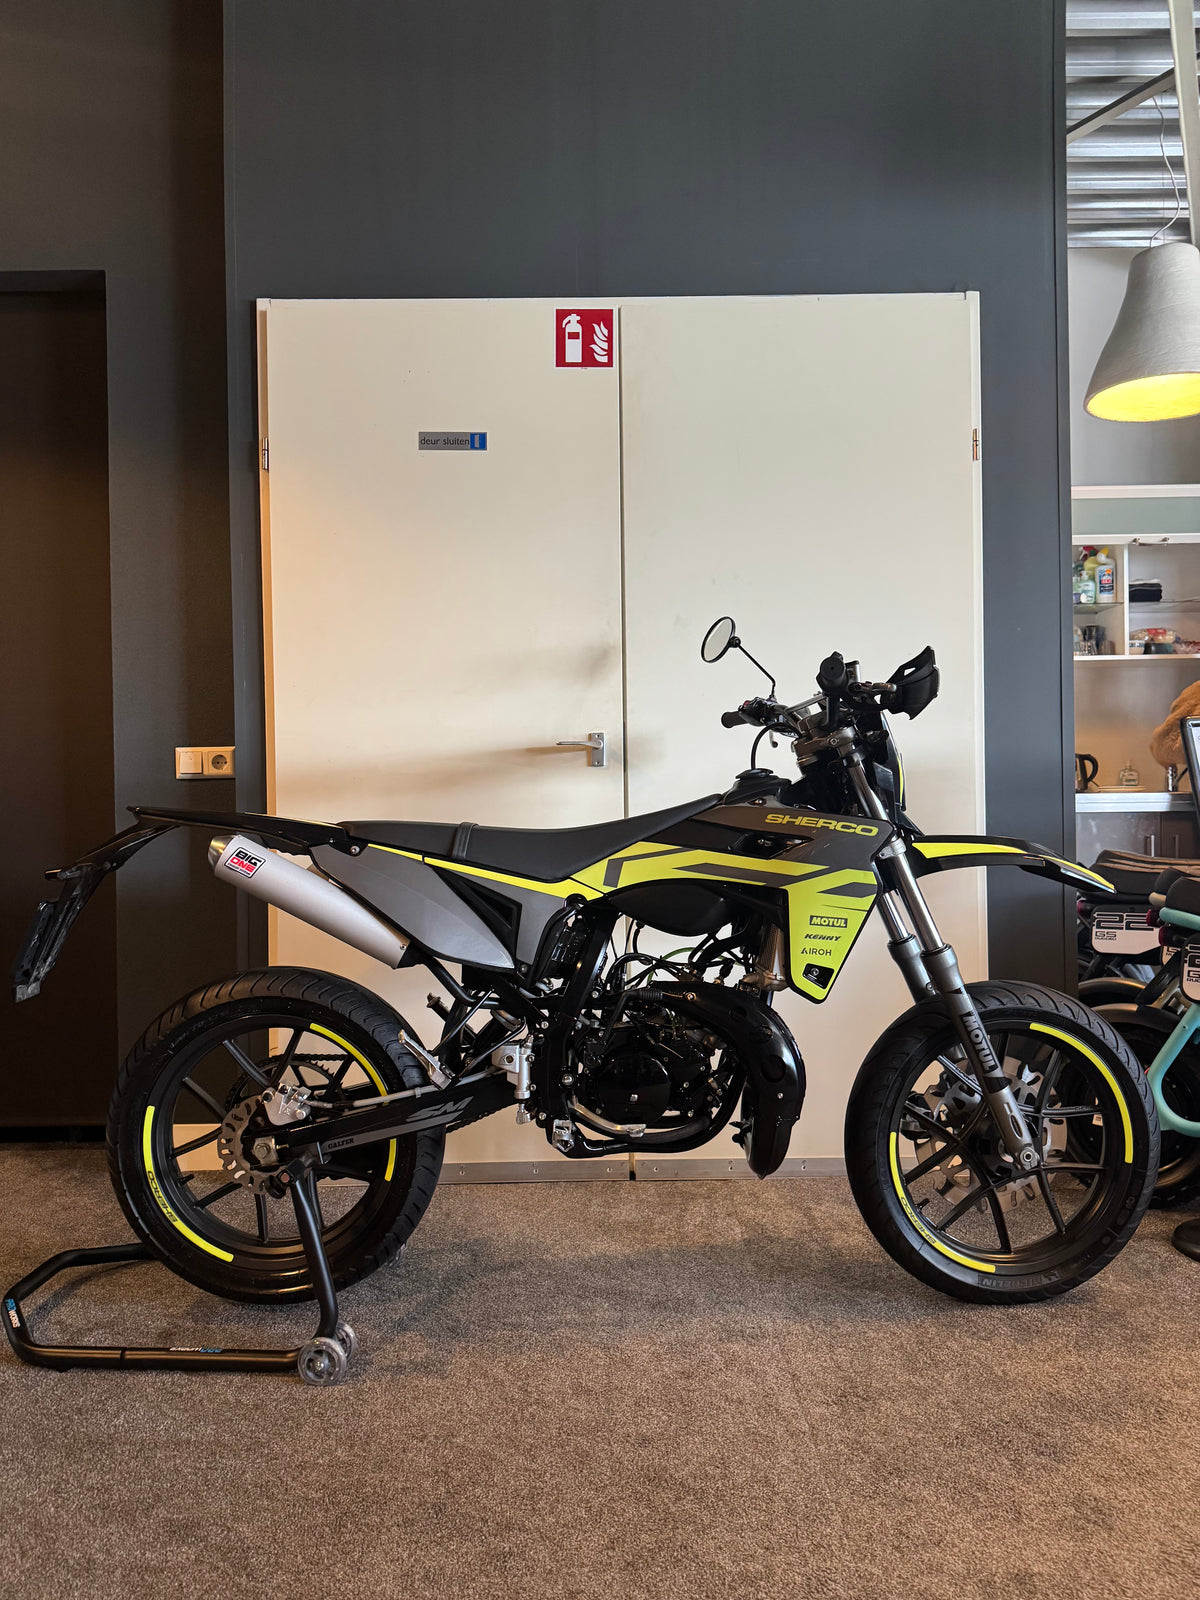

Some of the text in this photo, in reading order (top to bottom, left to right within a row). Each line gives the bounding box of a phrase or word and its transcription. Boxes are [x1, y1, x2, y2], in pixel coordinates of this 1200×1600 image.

[420, 436, 470, 446] deur sluiten
[765, 813, 879, 837] SHERCO
[229, 856, 256, 873] ONE
[235, 850, 263, 867] BIG
[810, 916, 847, 928] MOTUL
[804, 933, 842, 941] KENNY
[1094, 930, 1117, 938] GS
[801, 946, 832, 956] AIROH
[962, 1015, 997, 1071] MOTUL
[327, 1137, 355, 1150] GALFER
[147, 1170, 179, 1223] SHERCO
